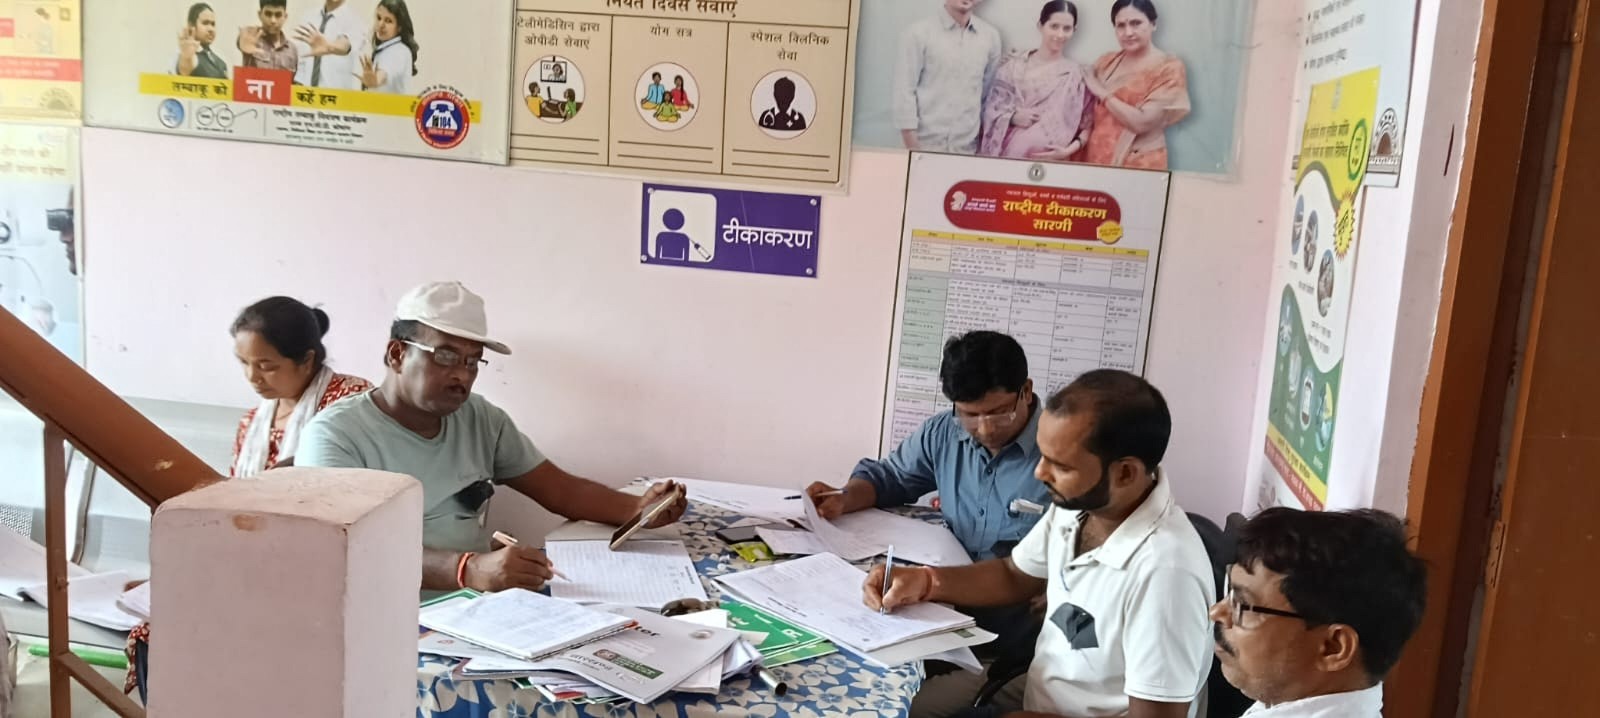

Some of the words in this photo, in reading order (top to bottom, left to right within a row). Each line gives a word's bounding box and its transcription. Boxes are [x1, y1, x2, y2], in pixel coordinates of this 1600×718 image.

[651, 24, 669, 36] योग
[751, 29, 782, 43] स्पेशल
[777, 48, 798, 61] सेवा
[213, 83, 228, 96] को
[245, 79, 275, 101] ना
[319, 94, 337, 106] हम
[1003, 198, 1042, 216] राष्ट्रीय
[1046, 201, 1108, 220] टीकाकरण
[722, 217, 813, 249] टीकाकरण
[1033, 218, 1073, 233] सारणी
